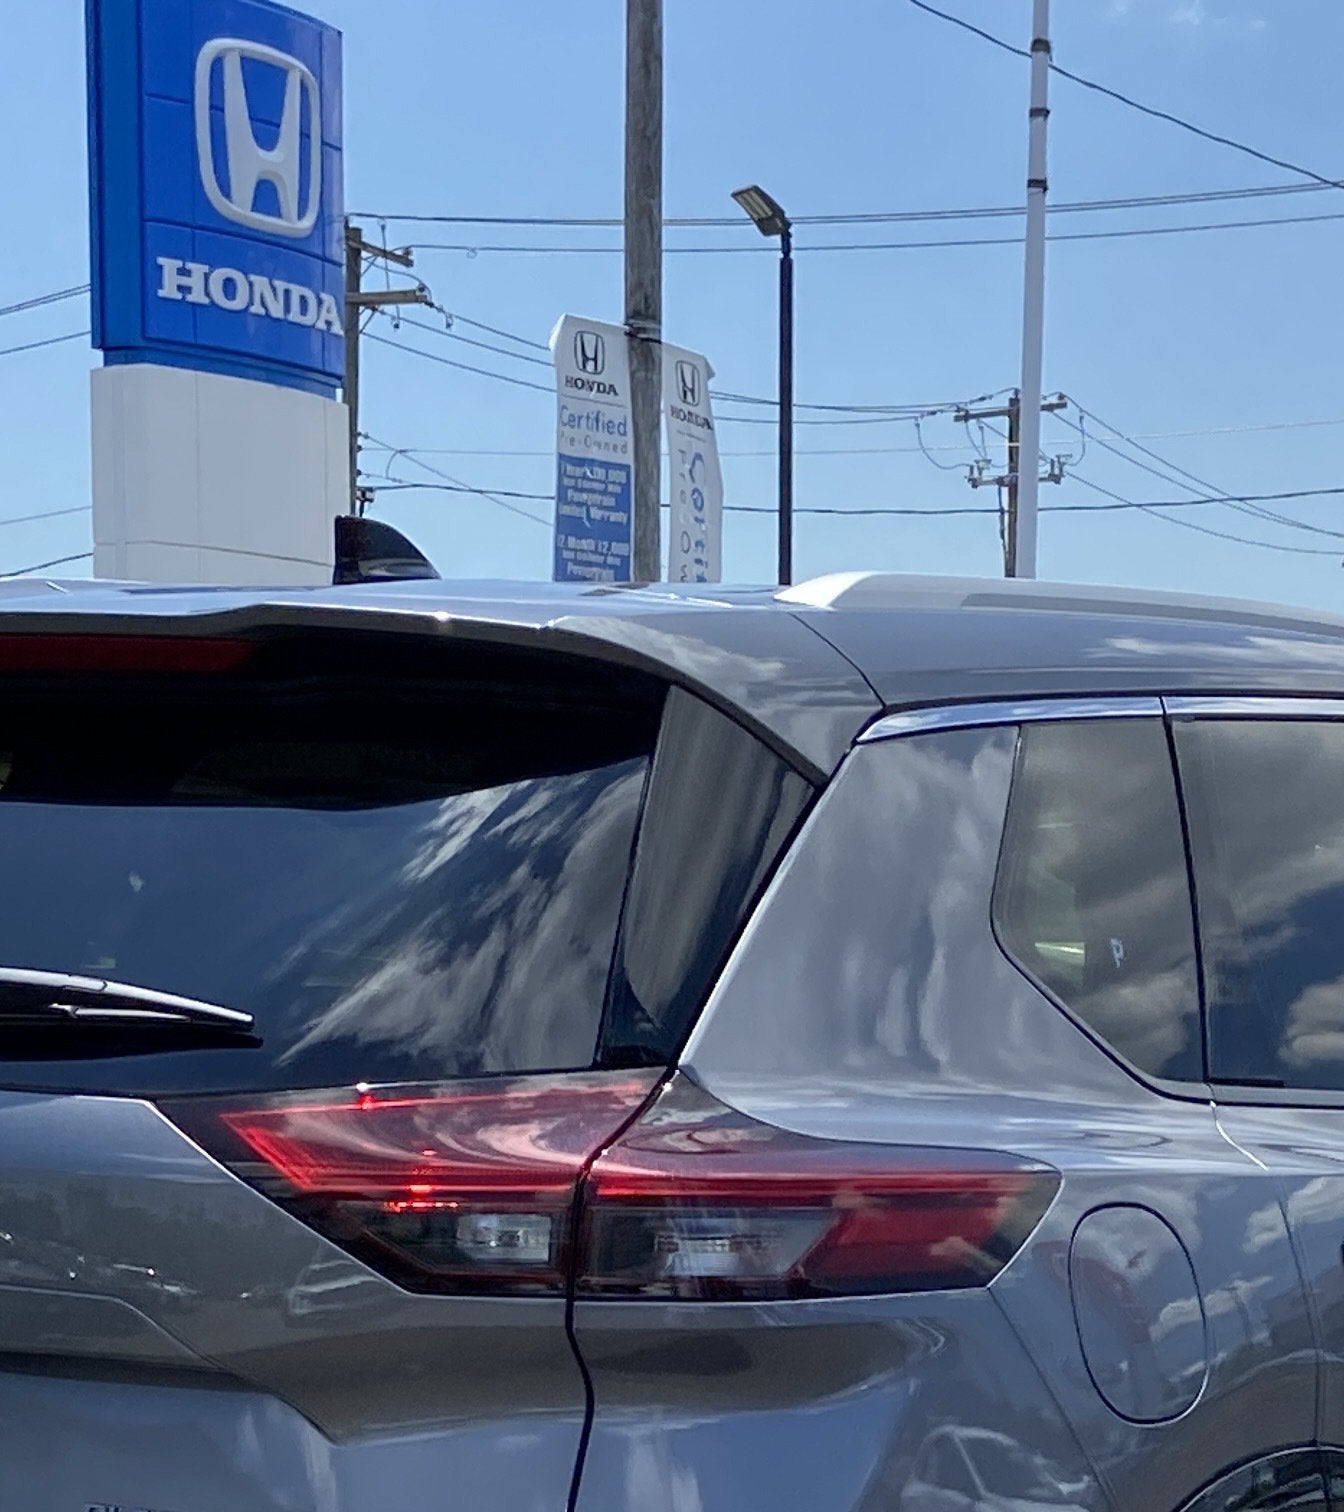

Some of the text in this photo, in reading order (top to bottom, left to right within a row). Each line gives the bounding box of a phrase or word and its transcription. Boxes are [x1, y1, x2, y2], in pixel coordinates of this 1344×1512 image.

[156, 256, 345, 338] HONDA
[564, 375, 619, 396] HONDA
[560, 404, 628, 437] Certified
